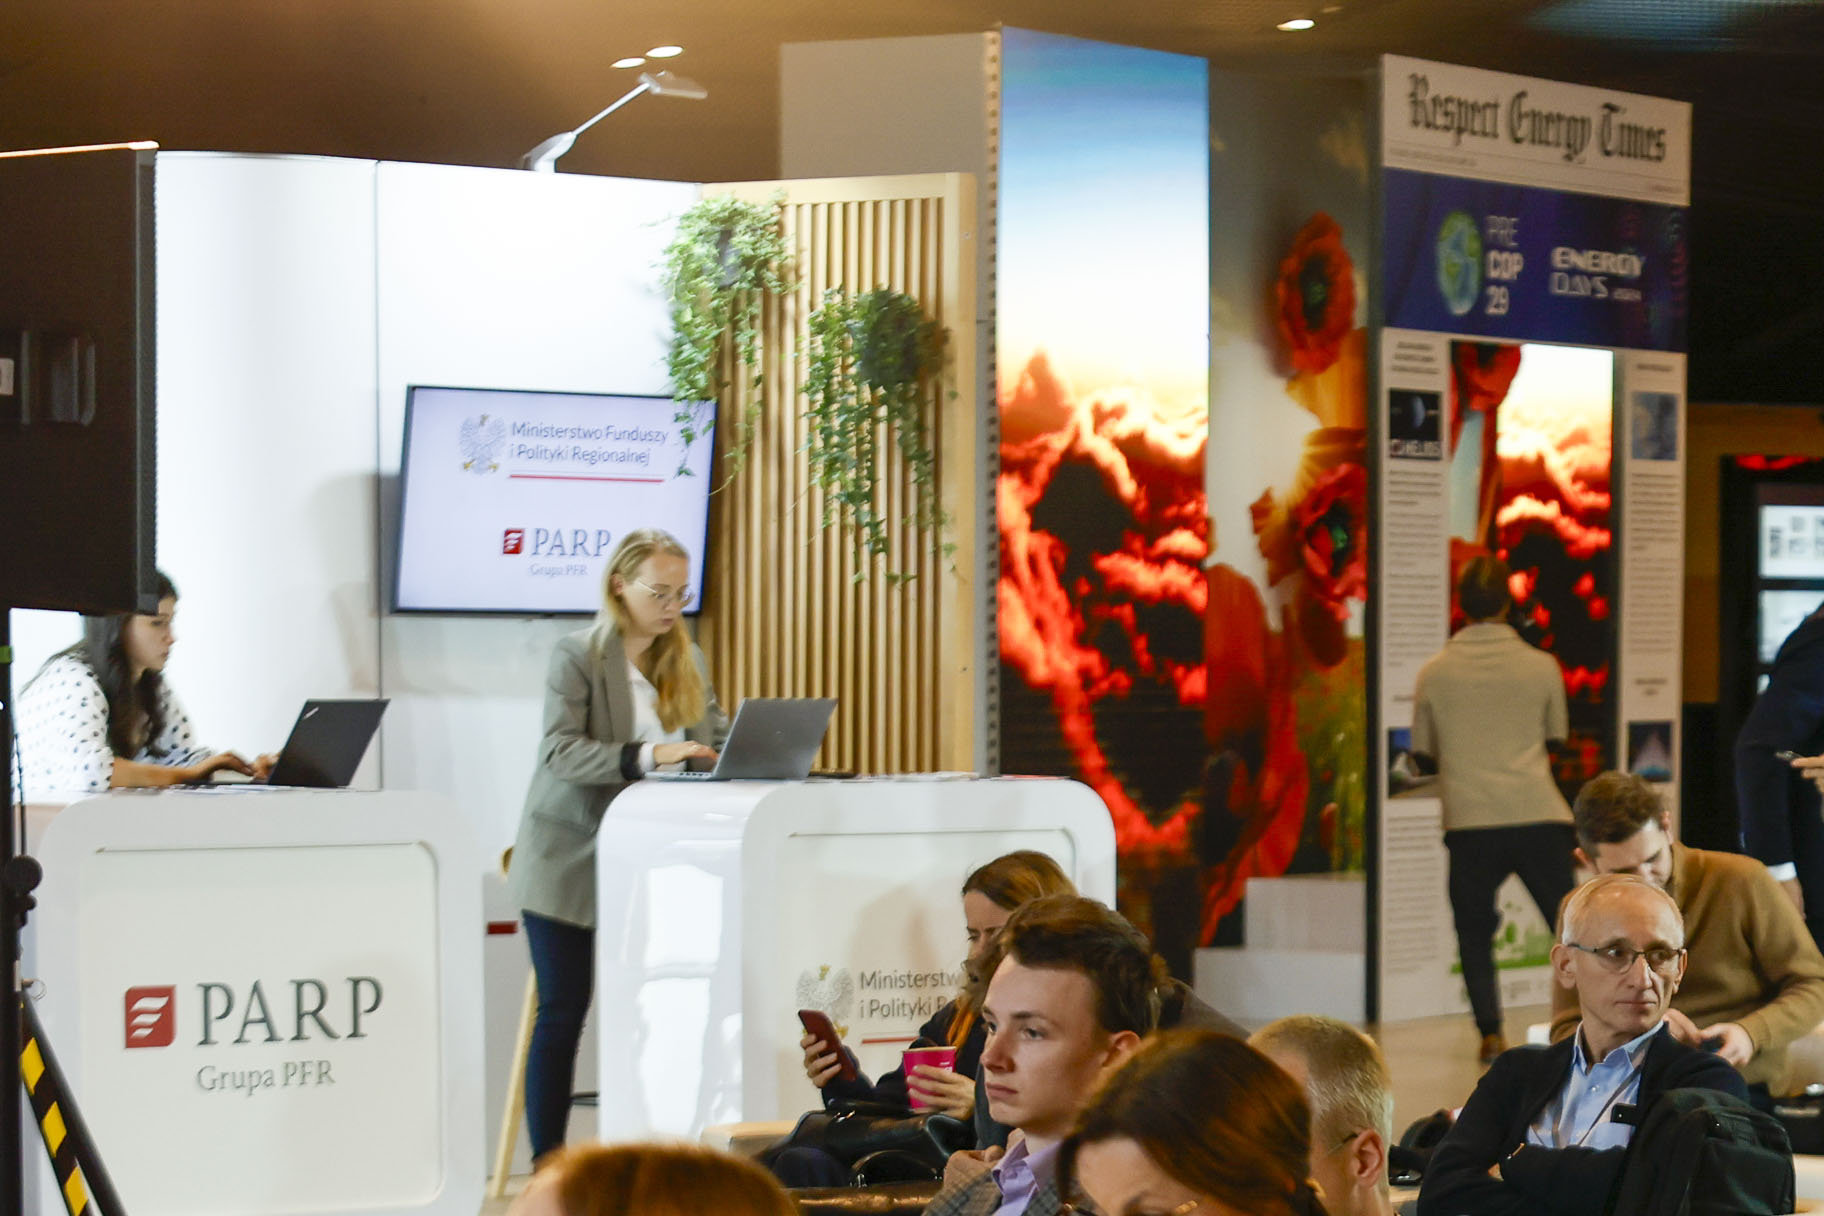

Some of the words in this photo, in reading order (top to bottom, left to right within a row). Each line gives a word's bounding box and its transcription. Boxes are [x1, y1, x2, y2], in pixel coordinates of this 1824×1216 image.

[1408, 73, 1500, 148] Respect
[1510, 90, 1592, 164] Energy
[1600, 102, 1667, 163] Times
[1486, 215, 1519, 247] PRE
[1486, 251, 1524, 281] COP
[1552, 246, 1646, 279] ENERGY
[1485, 285, 1510, 315] 29
[1551, 272, 1608, 299] DAYS
[512, 421, 602, 442] Ministerstwo
[606, 425, 669, 444] Funduszy
[517, 444, 569, 464] Polityki
[572, 446, 651, 466] Regionalnej
[531, 527, 611, 558] PARP
[529, 563, 563, 577] Grupa
[860, 969, 961, 991] Ministerstw
[196, 975, 384, 1047] PARP
[860, 1000, 865, 1018] i
[870, 998, 932, 1021] Polityki
[196, 1064, 275, 1098] Grupa
[282, 1060, 335, 1087] PFR
